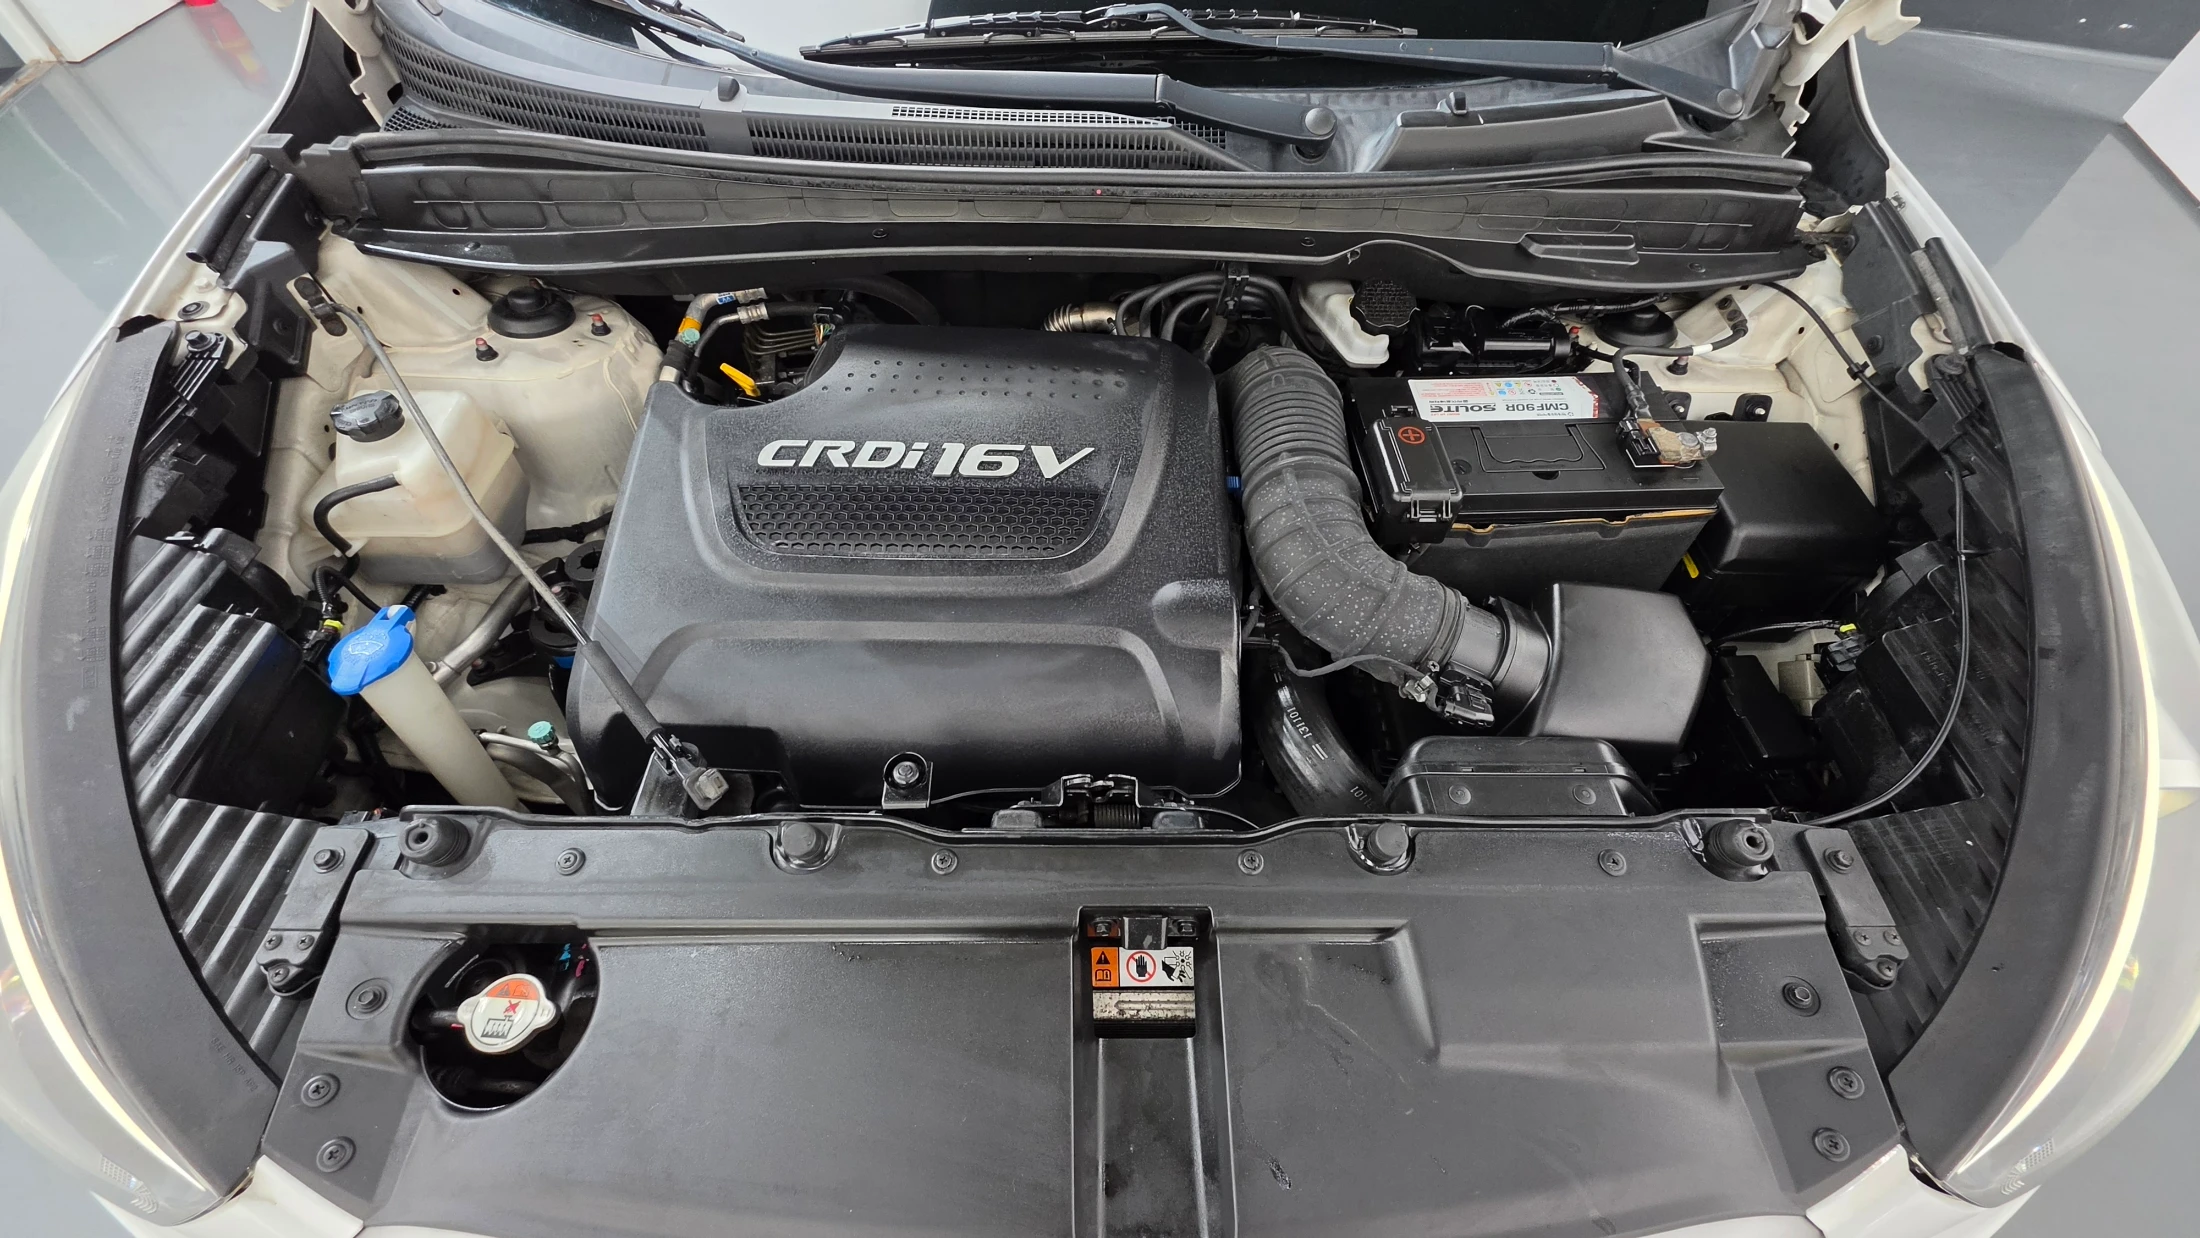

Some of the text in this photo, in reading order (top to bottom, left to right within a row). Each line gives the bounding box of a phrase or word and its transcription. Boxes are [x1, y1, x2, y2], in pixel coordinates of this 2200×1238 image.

[1430, 403, 1569, 412] CMF90R SOLITE
[757, 439, 1096, 480] CRDi 16V
[1287, 706, 1313, 739] 131101
